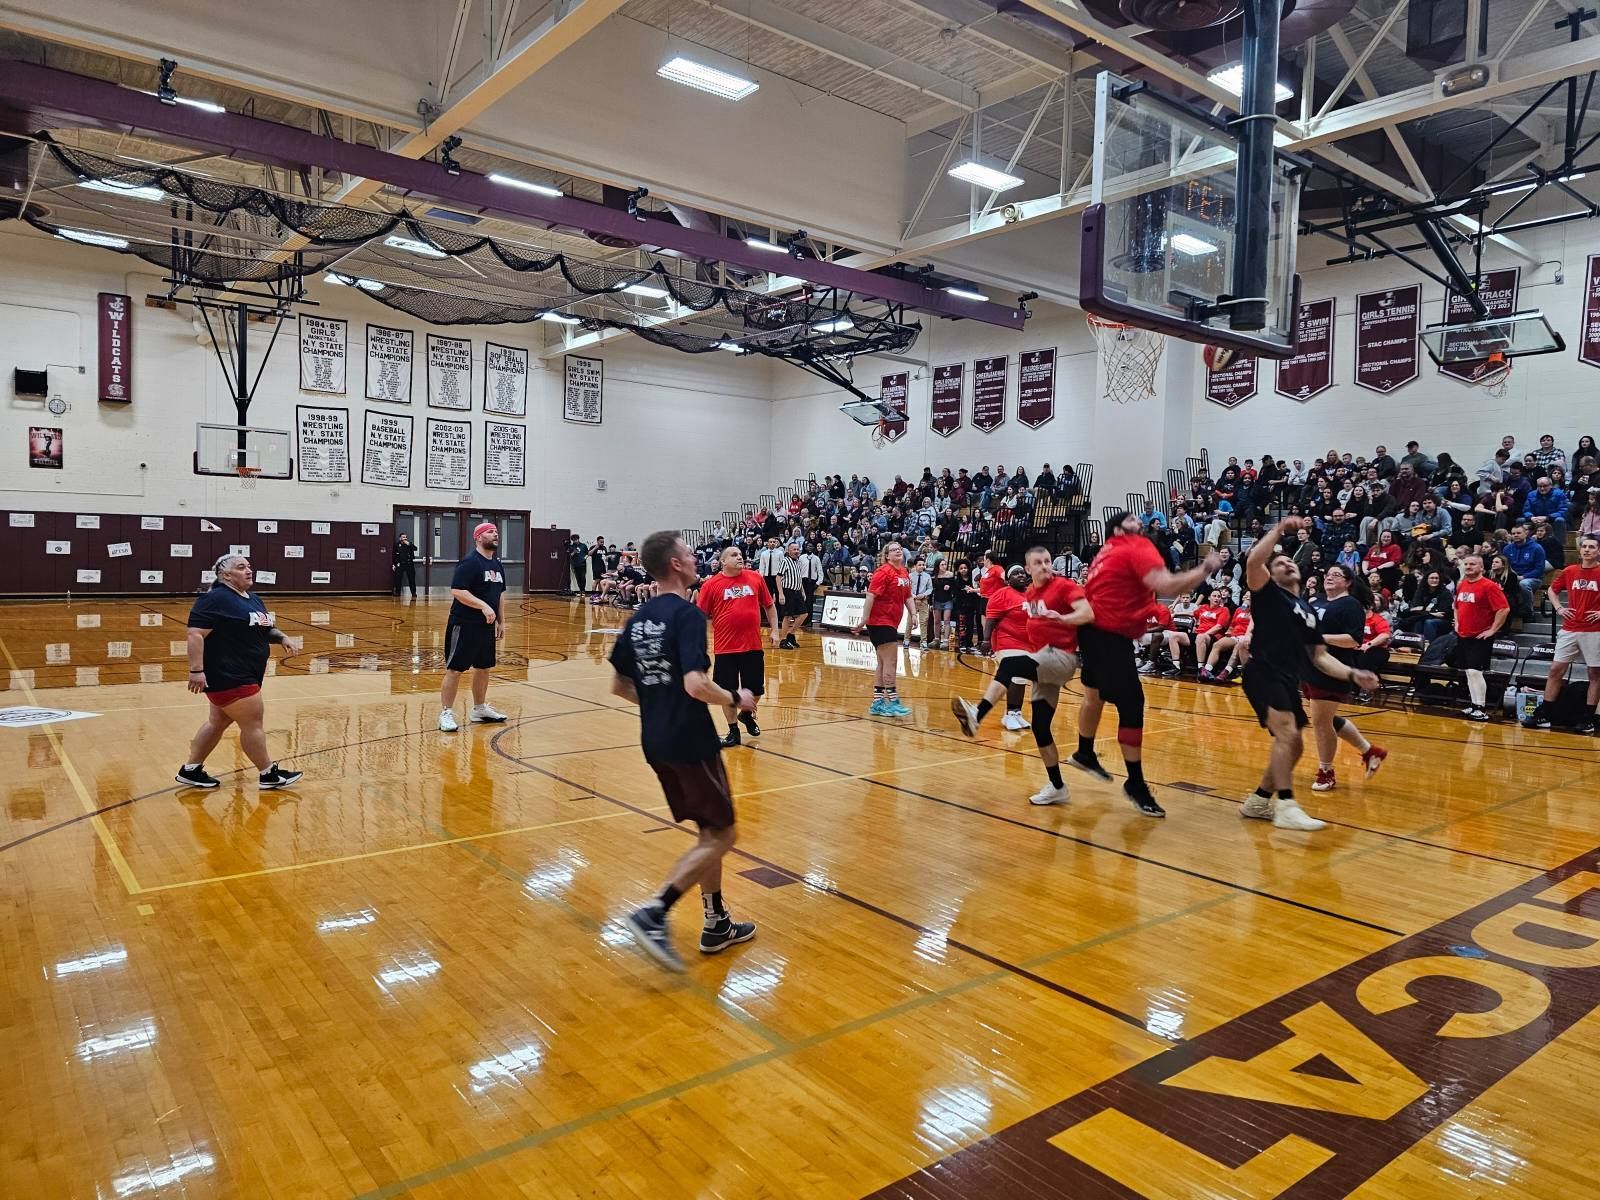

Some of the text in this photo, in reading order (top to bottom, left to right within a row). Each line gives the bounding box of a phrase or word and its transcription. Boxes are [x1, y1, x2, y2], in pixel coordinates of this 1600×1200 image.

[1479, 289, 1512, 300] TRACK
[1362, 305, 1415, 320] GIRLS TENNIS
[1307, 317, 1329, 327] SWIM
[311, 328, 336, 337] GIRLS
[319, 342, 344, 350] STATE
[370, 336, 410, 347] WRESTLING
[1383, 338, 1407, 346] CHAMPS
[108, 312, 124, 382] WILDCATS
[387, 346, 408, 355] STATE
[431, 345, 469, 356] WRESTLING
[303, 346, 344, 358] CHAMPIONS
[370, 351, 410, 362] CHAMPIONS
[446, 355, 466, 363] STATE
[1362, 357, 1412, 368] SECTIONAL CHAMPS
[430, 361, 469, 370] CHAMPIONS
[489, 363, 524, 374] CHAMPIONS
[505, 360, 524, 368] STATE
[568, 366, 584, 374] GIRLS
[570, 380, 598, 388] CHAMPIONS
[308, 414, 338, 422] 1998-99
[302, 421, 343, 430] WRESTLING
[372, 424, 405, 435] BASEBALL
[435, 424, 463, 433] 2002-03
[321, 430, 343, 438] STATE
[432, 431, 466, 440] WRESTLING
[490, 431, 522, 440] WRESTLING
[304, 437, 343, 445] CHAMPIONS
[384, 435, 406, 443] STATE
[502, 439, 520, 447] STATE
[369, 439, 407, 450] CHAMPIONS
[489, 444, 522, 453] CHAMPIONS
[431, 445, 466, 455] CHAMPIONS
